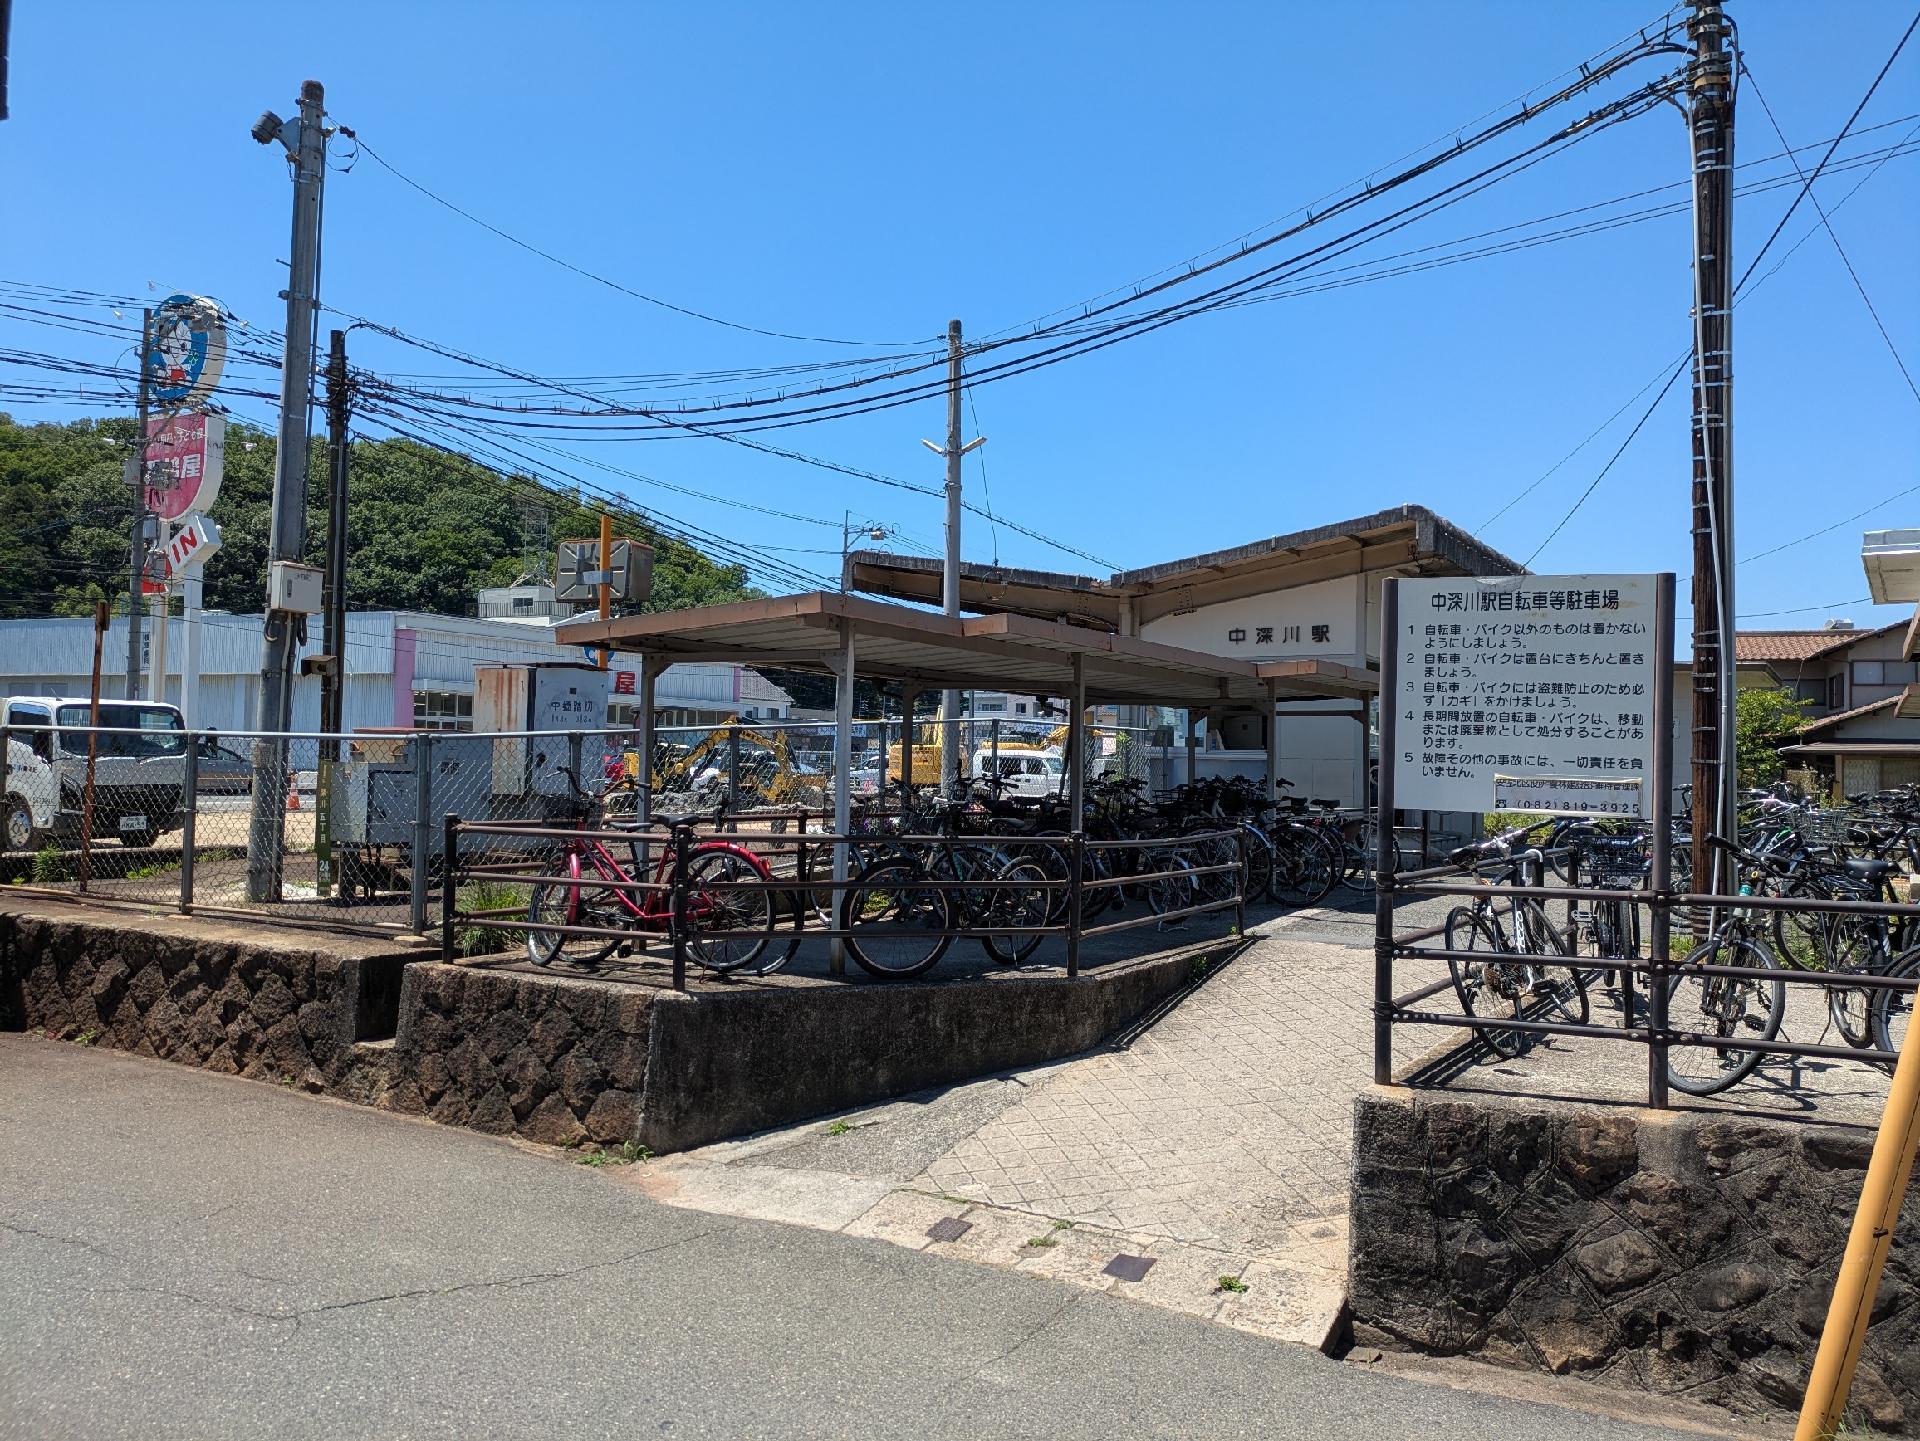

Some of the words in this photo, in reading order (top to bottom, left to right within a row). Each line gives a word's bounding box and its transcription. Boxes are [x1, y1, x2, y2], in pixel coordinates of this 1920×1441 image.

[172, 526, 197, 564] IN
[1431, 589, 1619, 612] 中深川駅自転車等駐車場
[1228, 625, 1330, 645] 中深川駅
[1407, 624, 1414, 635] 1
[1424, 637, 1527, 649] ようにしましょう。
[1406, 652, 1415, 664] 2
[1424, 666, 1479, 678] ましょう。
[1404, 710, 1414, 721] 4
[1423, 736, 1463, 749] ります。
[1404, 752, 1414, 763] 5
[1422, 765, 1475, 779] いません。
